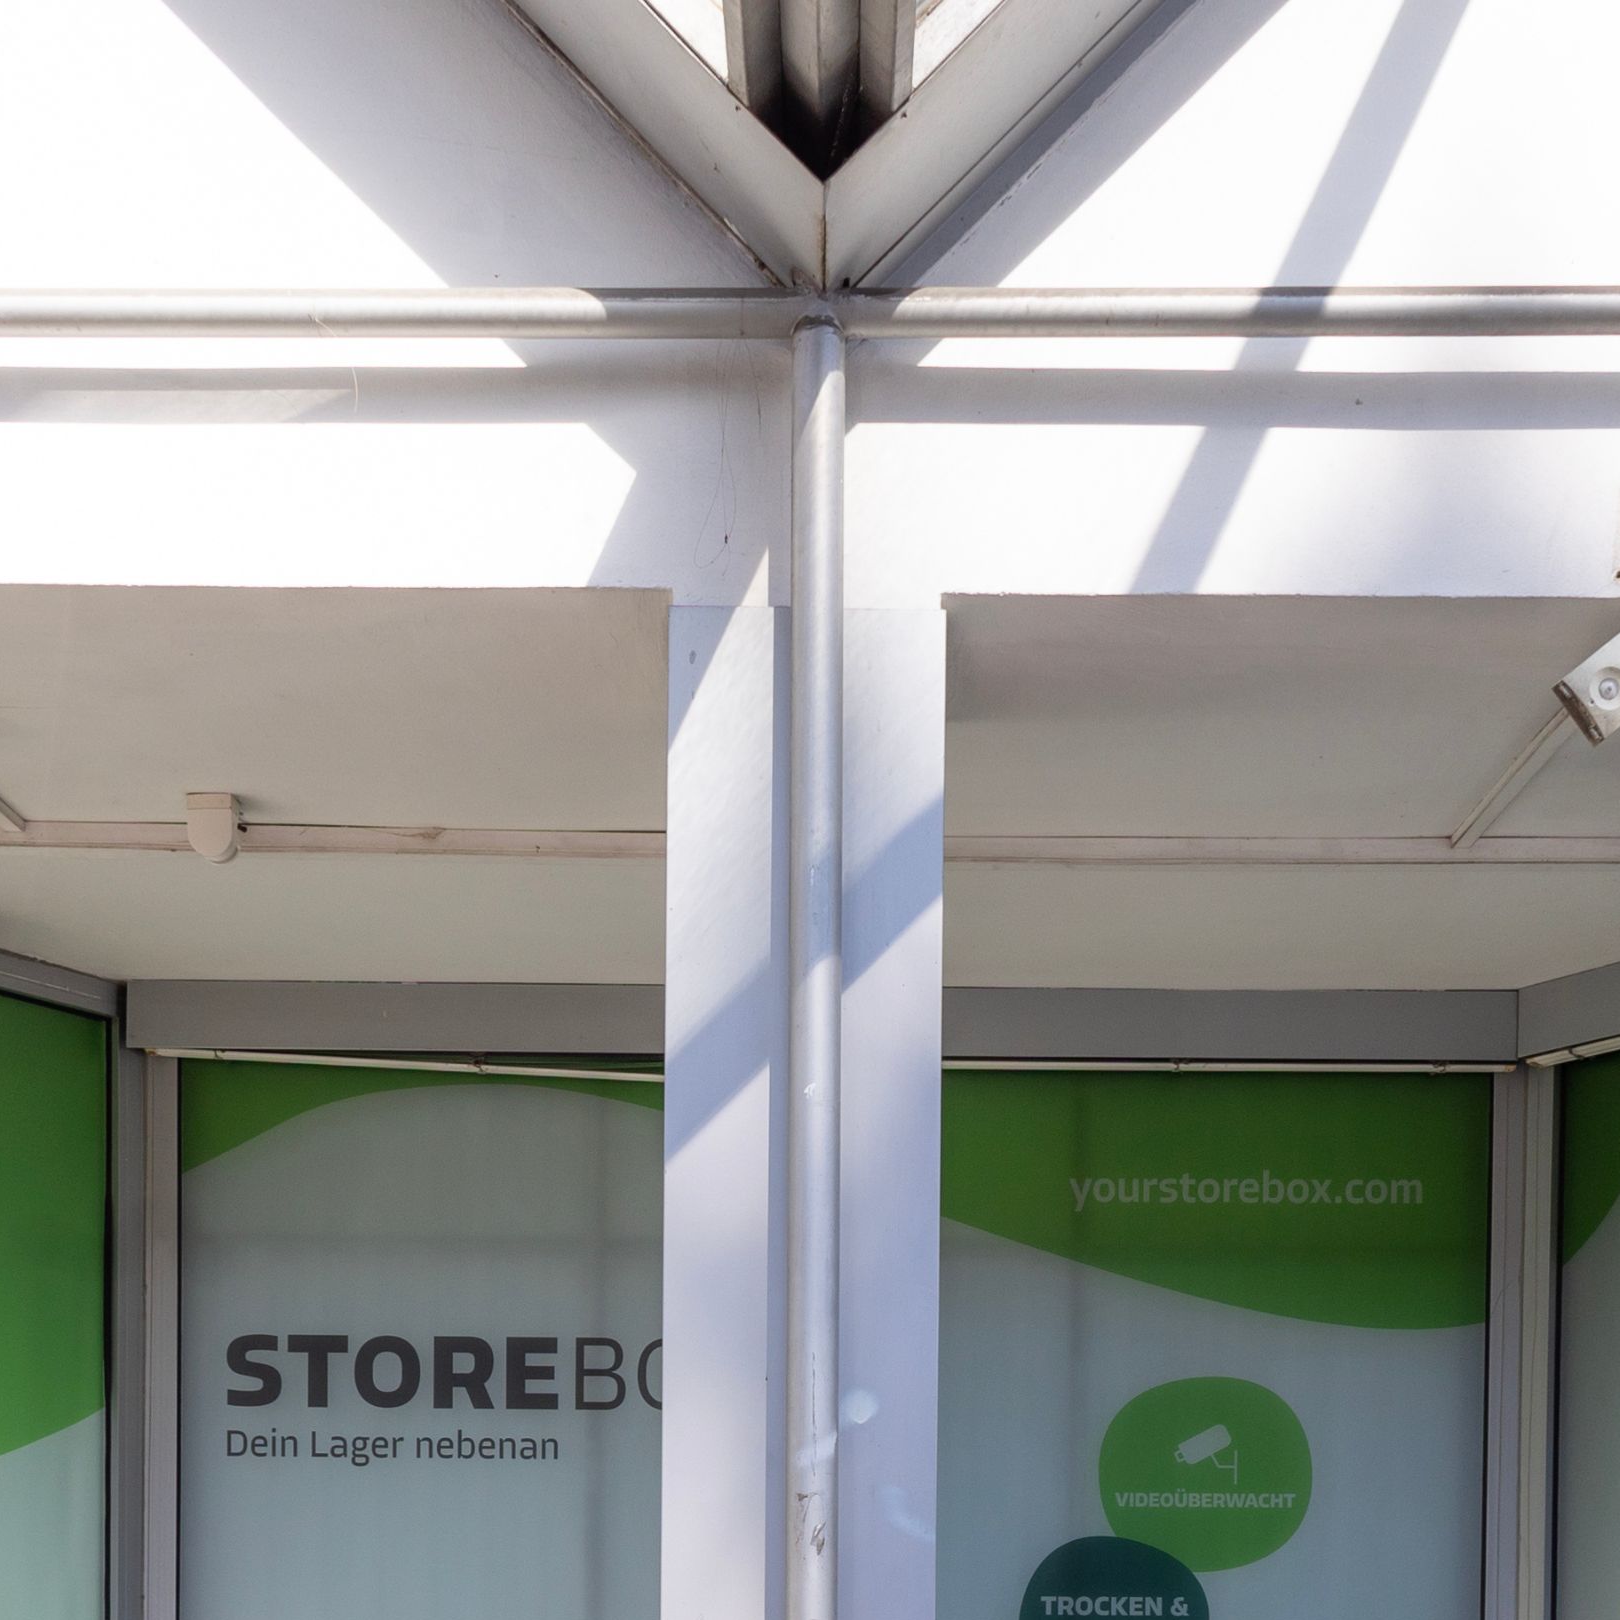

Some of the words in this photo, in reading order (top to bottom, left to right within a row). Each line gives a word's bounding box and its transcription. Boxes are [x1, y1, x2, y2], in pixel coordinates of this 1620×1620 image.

[1070, 1170, 1422, 1212] yourstorebox.com
[226, 1334, 662, 1411] STOREB
[226, 1428, 298, 1458] Dein
[311, 1430, 404, 1467] Lager
[416, 1429, 559, 1460] nebenan
[1115, 1488, 1296, 1509] VIDEOÜBERWACHT
[1040, 1595, 1163, 1617] TROCKEN
[1170, 1595, 1189, 1617] &
